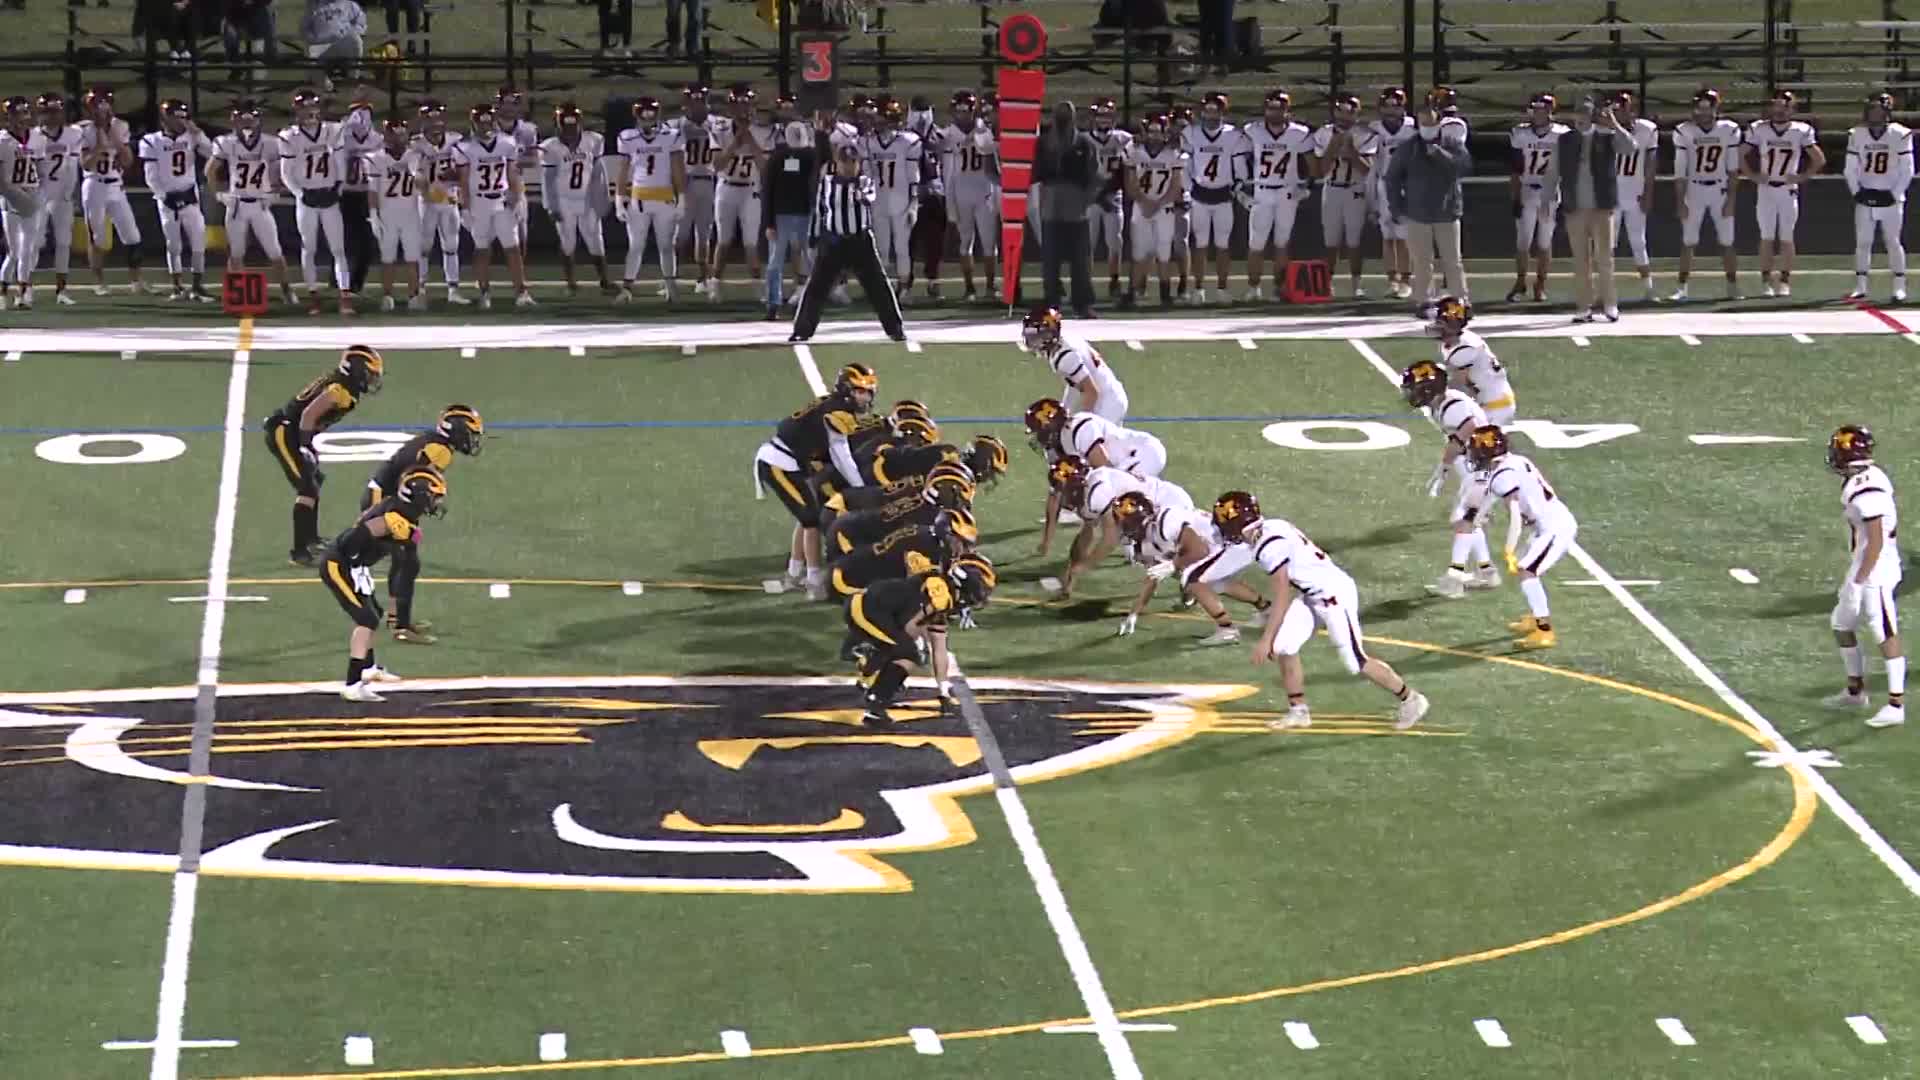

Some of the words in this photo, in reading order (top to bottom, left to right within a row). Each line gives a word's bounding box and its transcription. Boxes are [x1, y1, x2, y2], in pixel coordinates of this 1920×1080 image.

[802, 42, 832, 82] 3
[48, 154, 63, 181] 2
[172, 151, 186, 177] 9
[306, 152, 330, 179] 14
[646, 155, 655, 176] 1
[1204, 154, 1219, 181] 4
[1260, 151, 1291, 179] 54
[1530, 150, 1553, 175] 12
[1696, 145, 1722, 173] 19
[1767, 148, 1793, 176] 17
[1864, 151, 1888, 174] 18
[235, 162, 265, 189] 34
[478, 163, 505, 190] 32
[879, 161, 896, 188] 11
[1139, 170, 1169, 194] 47
[226, 272, 264, 305] 50
[1295, 262, 1329, 297] 40
